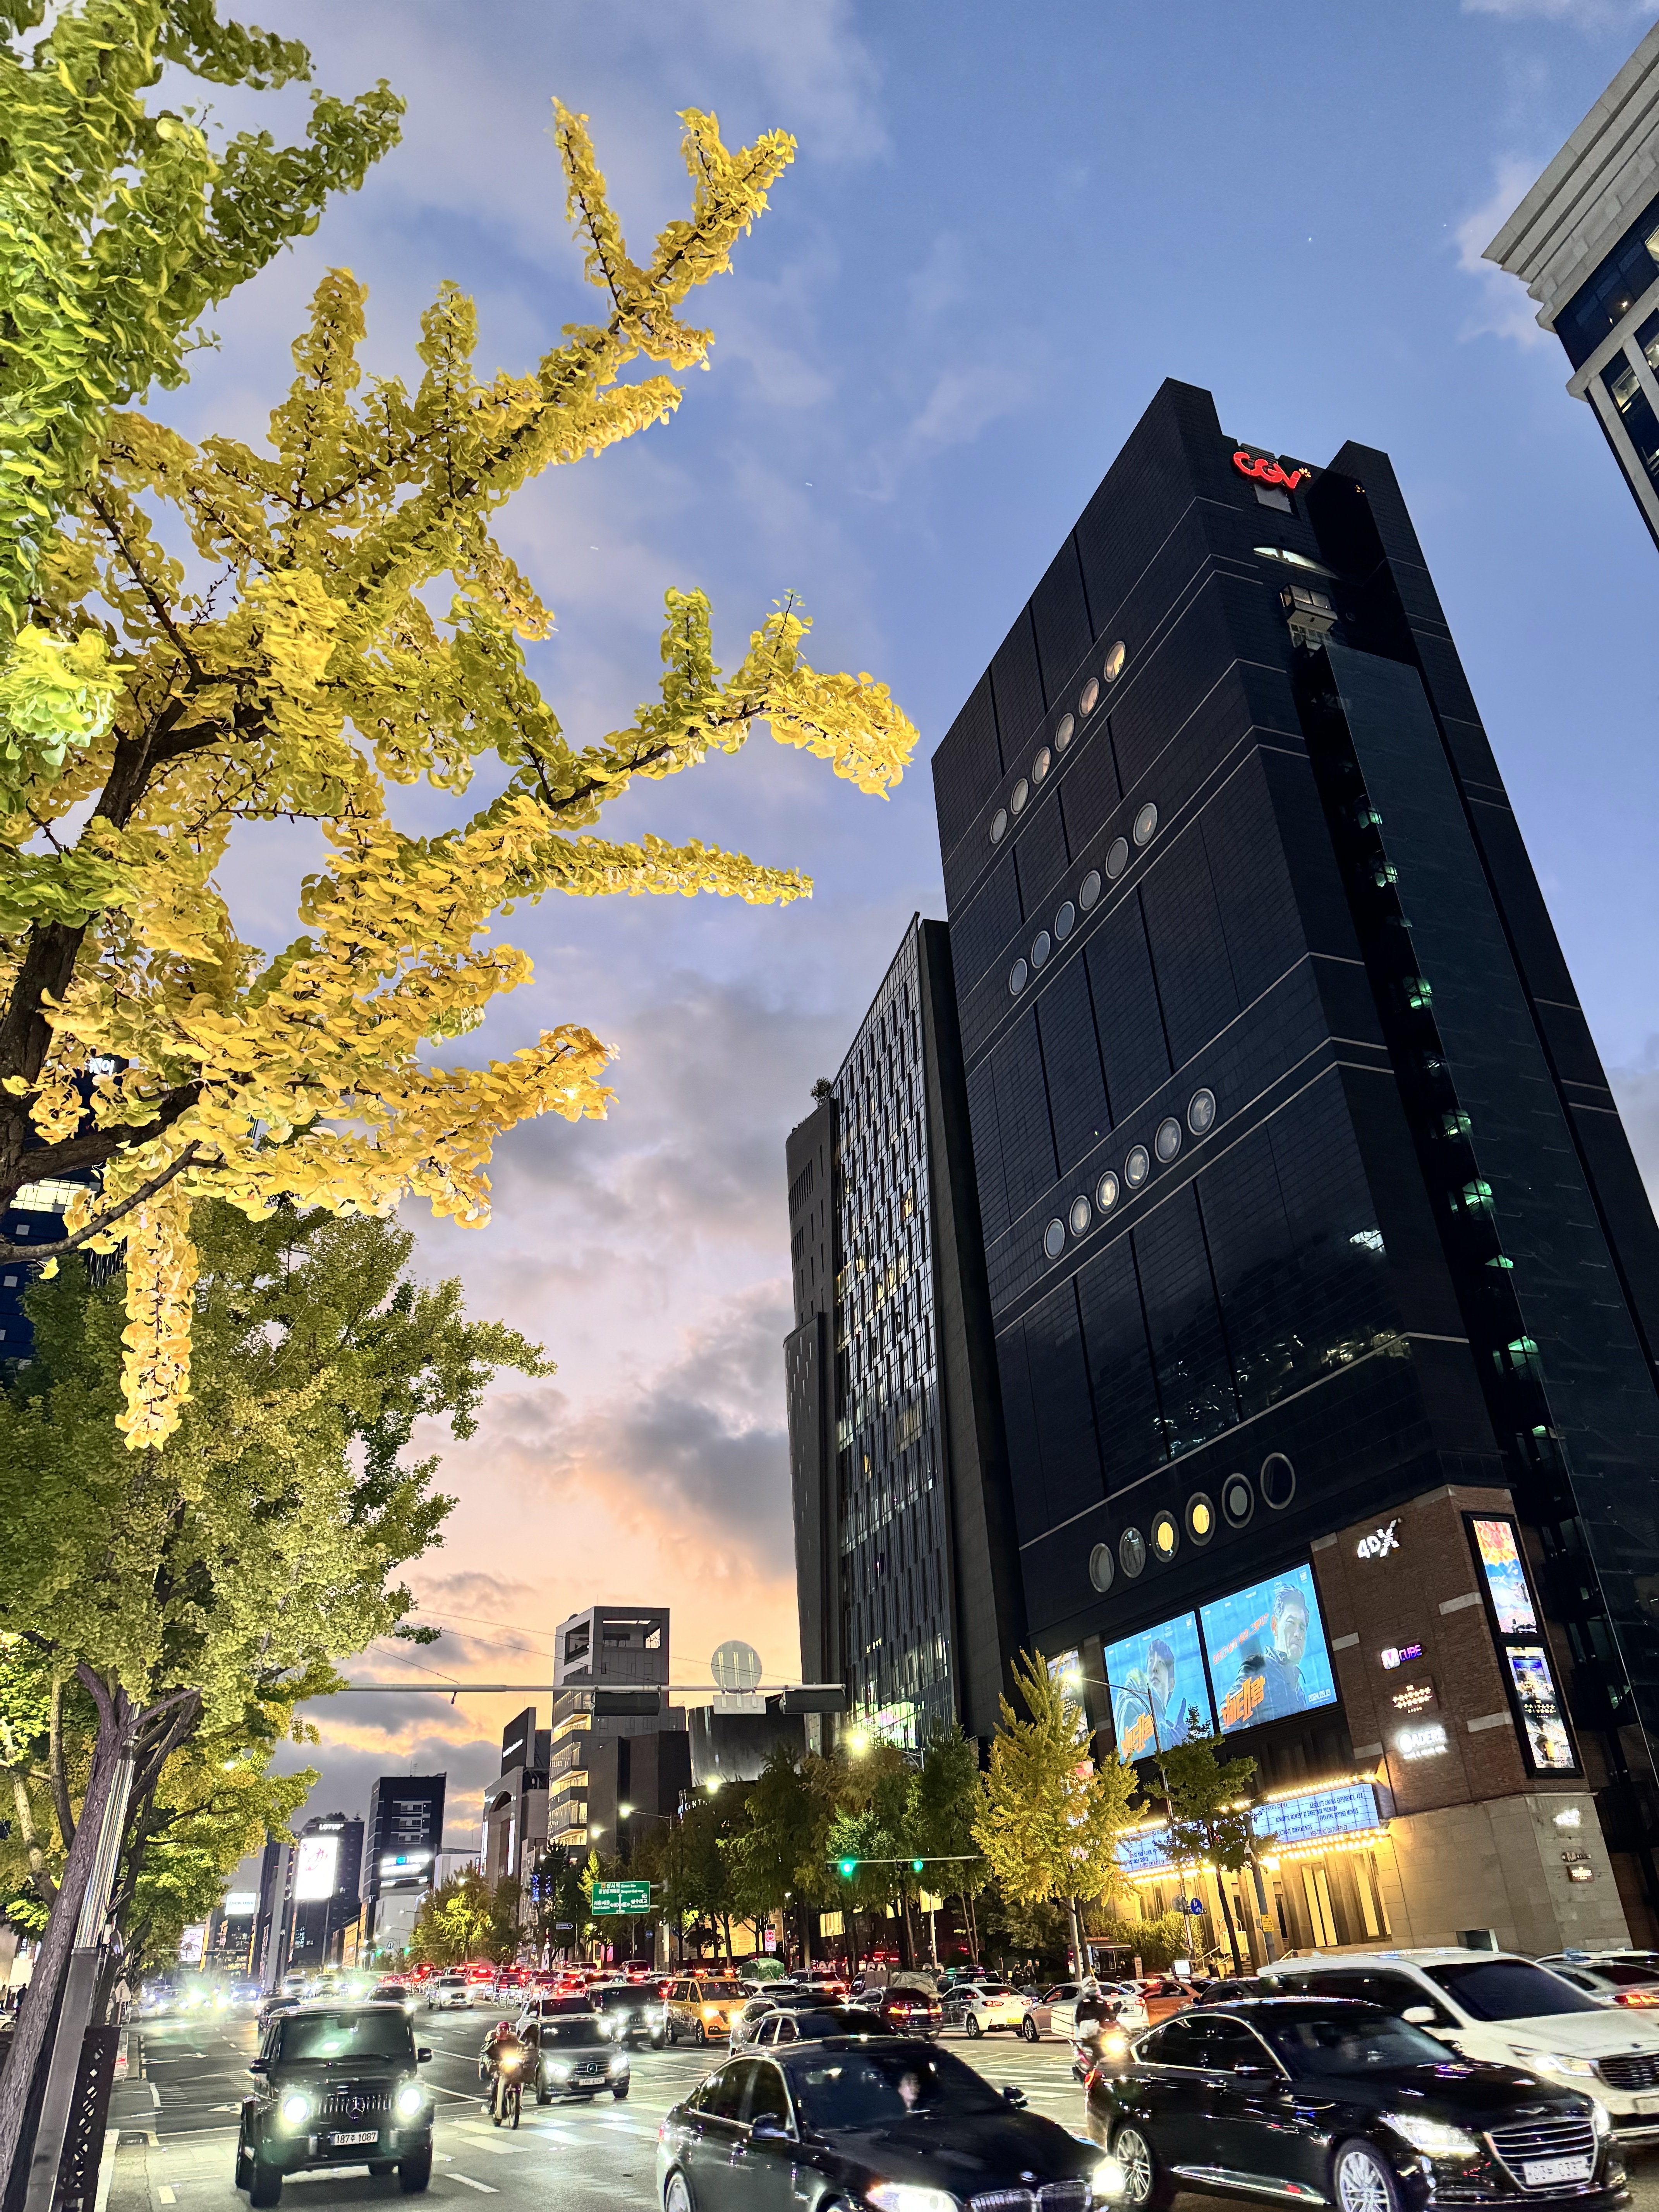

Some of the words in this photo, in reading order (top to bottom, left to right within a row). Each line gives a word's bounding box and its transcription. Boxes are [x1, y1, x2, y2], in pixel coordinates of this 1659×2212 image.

[1233, 452, 1301, 489] CGV
[1357, 1518, 1400, 1558] 4DX
[1399, 1644, 1422, 1661] CUBE
[1392, 1687, 1432, 1703] PRIVATE
[1394, 1695, 1433, 1709] CINEMA
[1412, 1728, 1444, 1748] ADERE
[1325, 1798, 1336, 1806] CINEMA
[337, 2135, 356, 2143] 187주
[359, 2132, 377, 2142] 1087
